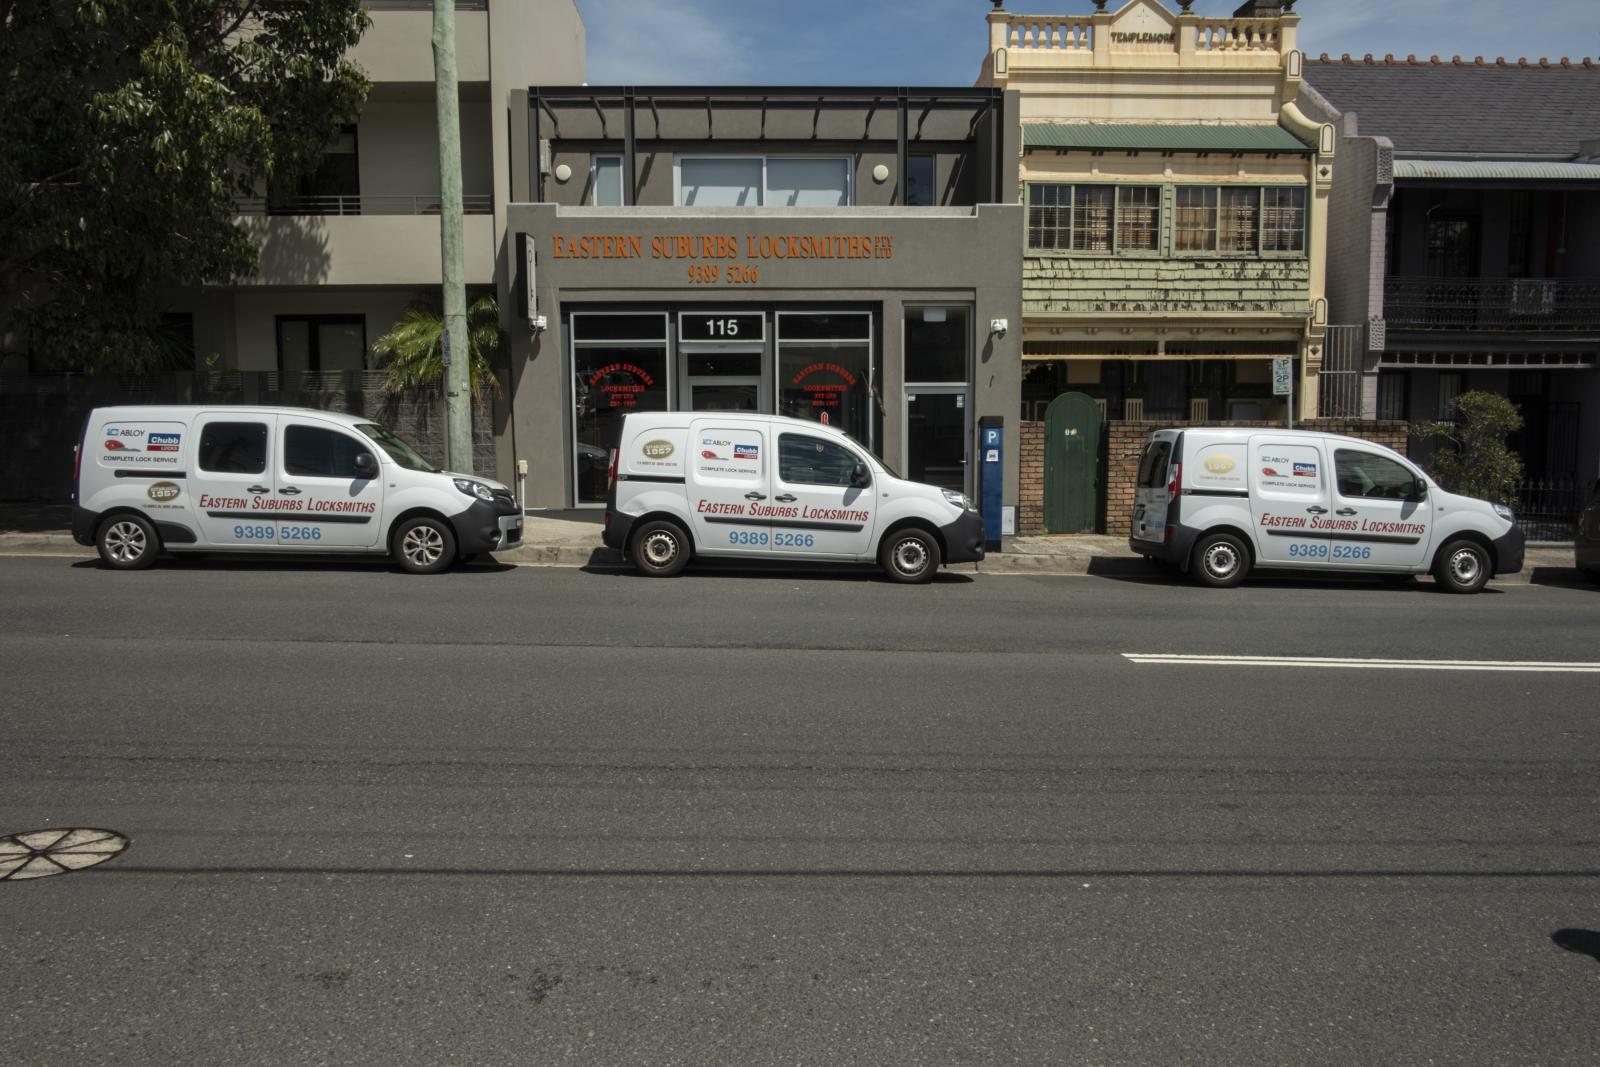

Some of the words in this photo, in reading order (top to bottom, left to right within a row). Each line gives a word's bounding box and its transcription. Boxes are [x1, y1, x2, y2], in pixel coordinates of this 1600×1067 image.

[1110, 31, 1176, 44] TEMPLEMORE
[552, 235, 643, 259] EASTERN
[651, 235, 737, 259] SUBURBS
[747, 235, 872, 259] LOCKSMITHS
[874, 236, 893, 247] PTY
[874, 247, 892, 259] LTD
[687, 264, 721, 284] 9389
[726, 265, 759, 284] 5266
[706, 319, 738, 336] 115
[1276, 374, 1289, 382] 2P
[120, 429, 145, 437] ABLOY
[151, 436, 179, 444] Chubb
[988, 431, 997, 444] P
[199, 494, 249, 509] EASTERN
[252, 496, 303, 511] SUBURBS
[307, 498, 376, 513] LOCKSMITHS
[697, 499, 745, 515] EASTERN
[749, 502, 799, 518] SUBURBS
[802, 505, 869, 522] LOCKSMITHS
[1260, 512, 1307, 527] EASTERN
[1310, 515, 1358, 531] SUBURBS
[1361, 518, 1425, 534] LOCKSMITHS
[234, 525, 275, 539] 9389
[281, 527, 321, 540] 5266
[728, 531, 769, 545] 9389
[774, 533, 814, 547] 5266
[1289, 544, 1328, 557] 9389
[1332, 545, 1371, 559] 5266
